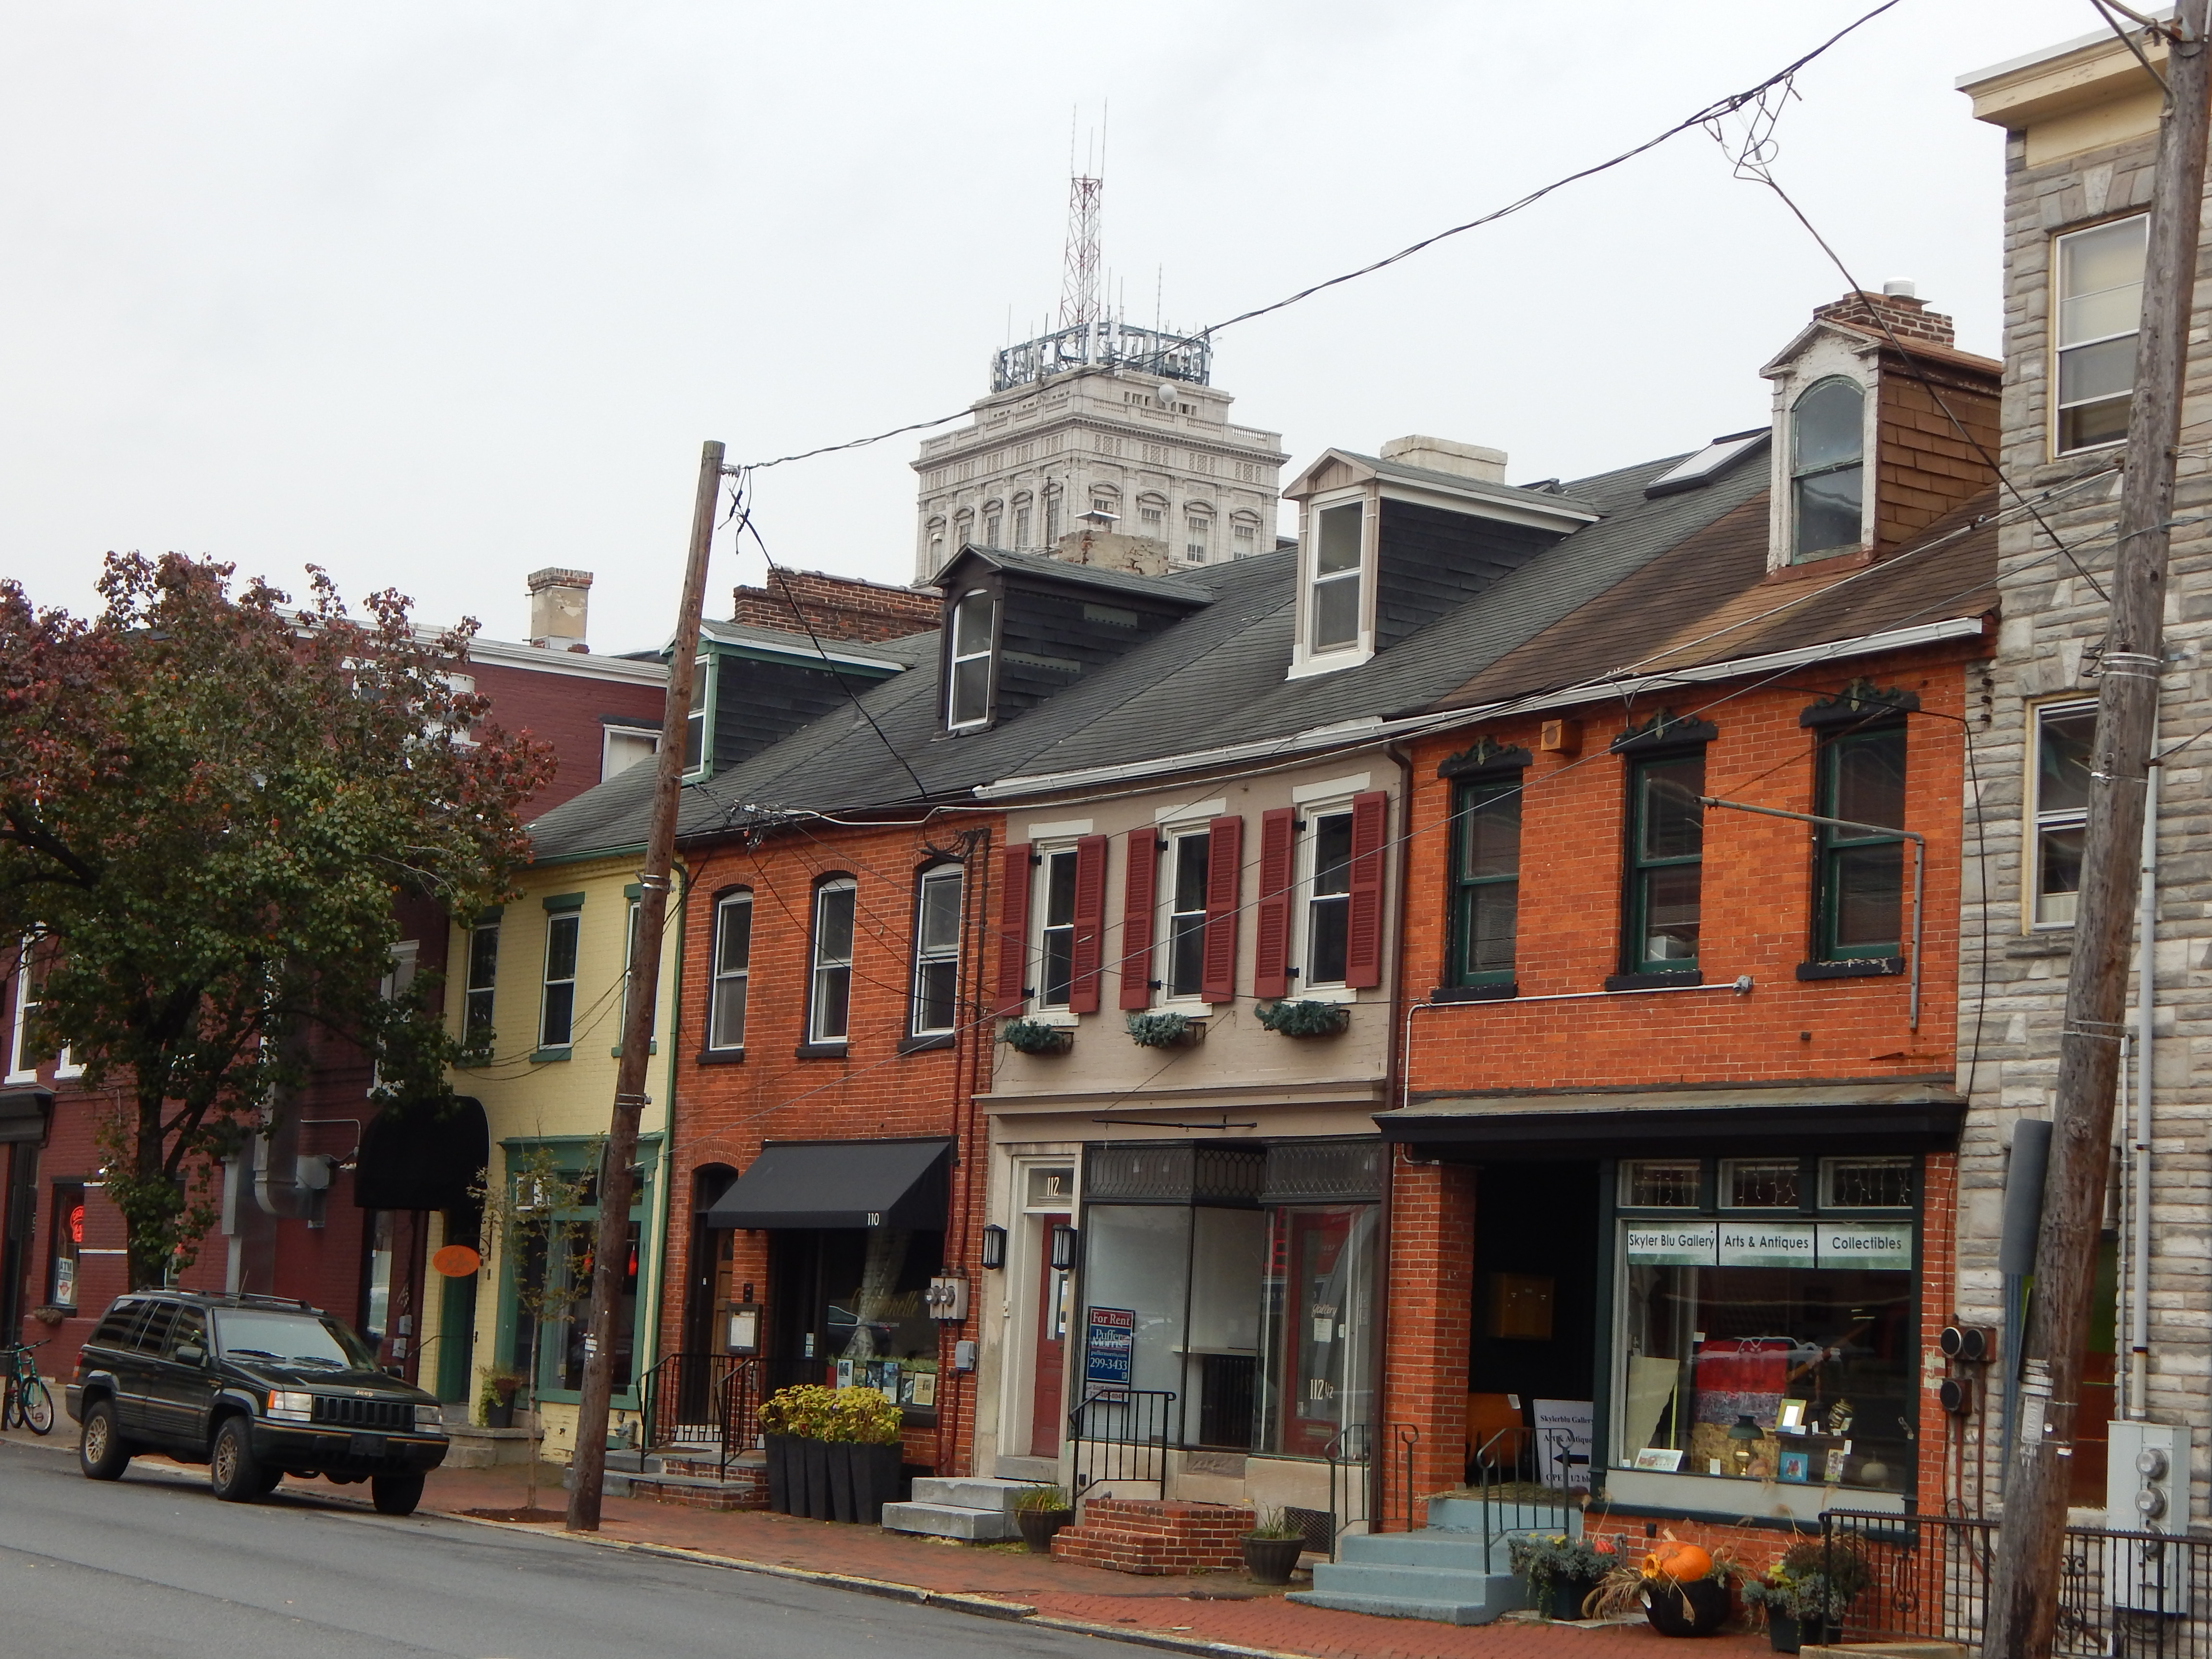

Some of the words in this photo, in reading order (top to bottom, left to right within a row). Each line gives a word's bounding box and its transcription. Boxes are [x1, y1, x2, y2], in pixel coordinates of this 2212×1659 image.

[1047, 1177, 1059, 1196] 112
[867, 1213, 879, 1226] 110
[1629, 1234, 1658, 1249] Skyler
[1661, 1235, 1675, 1246] Blu
[1678, 1234, 1715, 1249] Gallery
[1724, 1235, 1744, 1247] Arts
[1748, 1236, 1755, 1248] &
[1759, 1236, 1808, 1250] Antiques
[1832, 1237, 1901, 1249] Collectibles
[1093, 1311, 1107, 1324] For
[1110, 1313, 1130, 1326] Rent
[1090, 1358, 1127, 1370] 299-3433
[1310, 1379, 1324, 1399] 112
